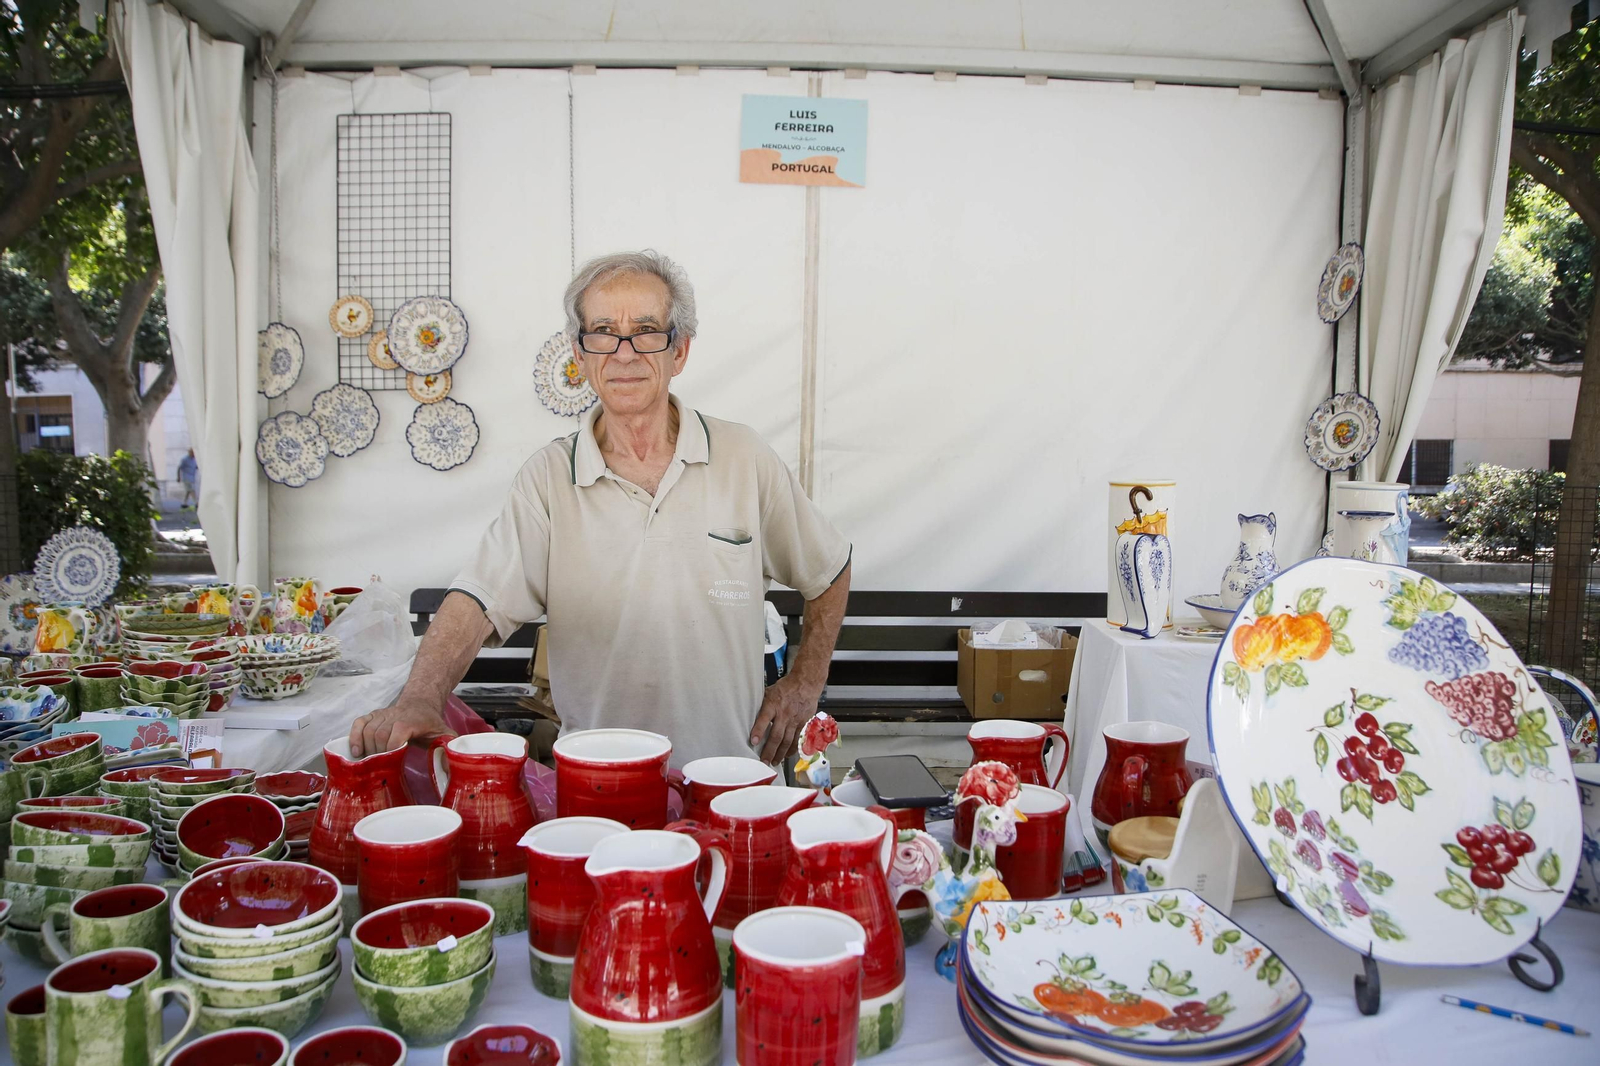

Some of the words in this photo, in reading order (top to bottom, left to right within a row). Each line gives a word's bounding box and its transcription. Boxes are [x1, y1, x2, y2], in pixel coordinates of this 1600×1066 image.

[789, 110, 817, 120] LUIS
[774, 122, 834, 133] FERREIRA
[761, 143, 801, 151] MENDALVO
[807, 145, 845, 153] ALCOBAÇA
[771, 163, 835, 174] PORTUGAL
